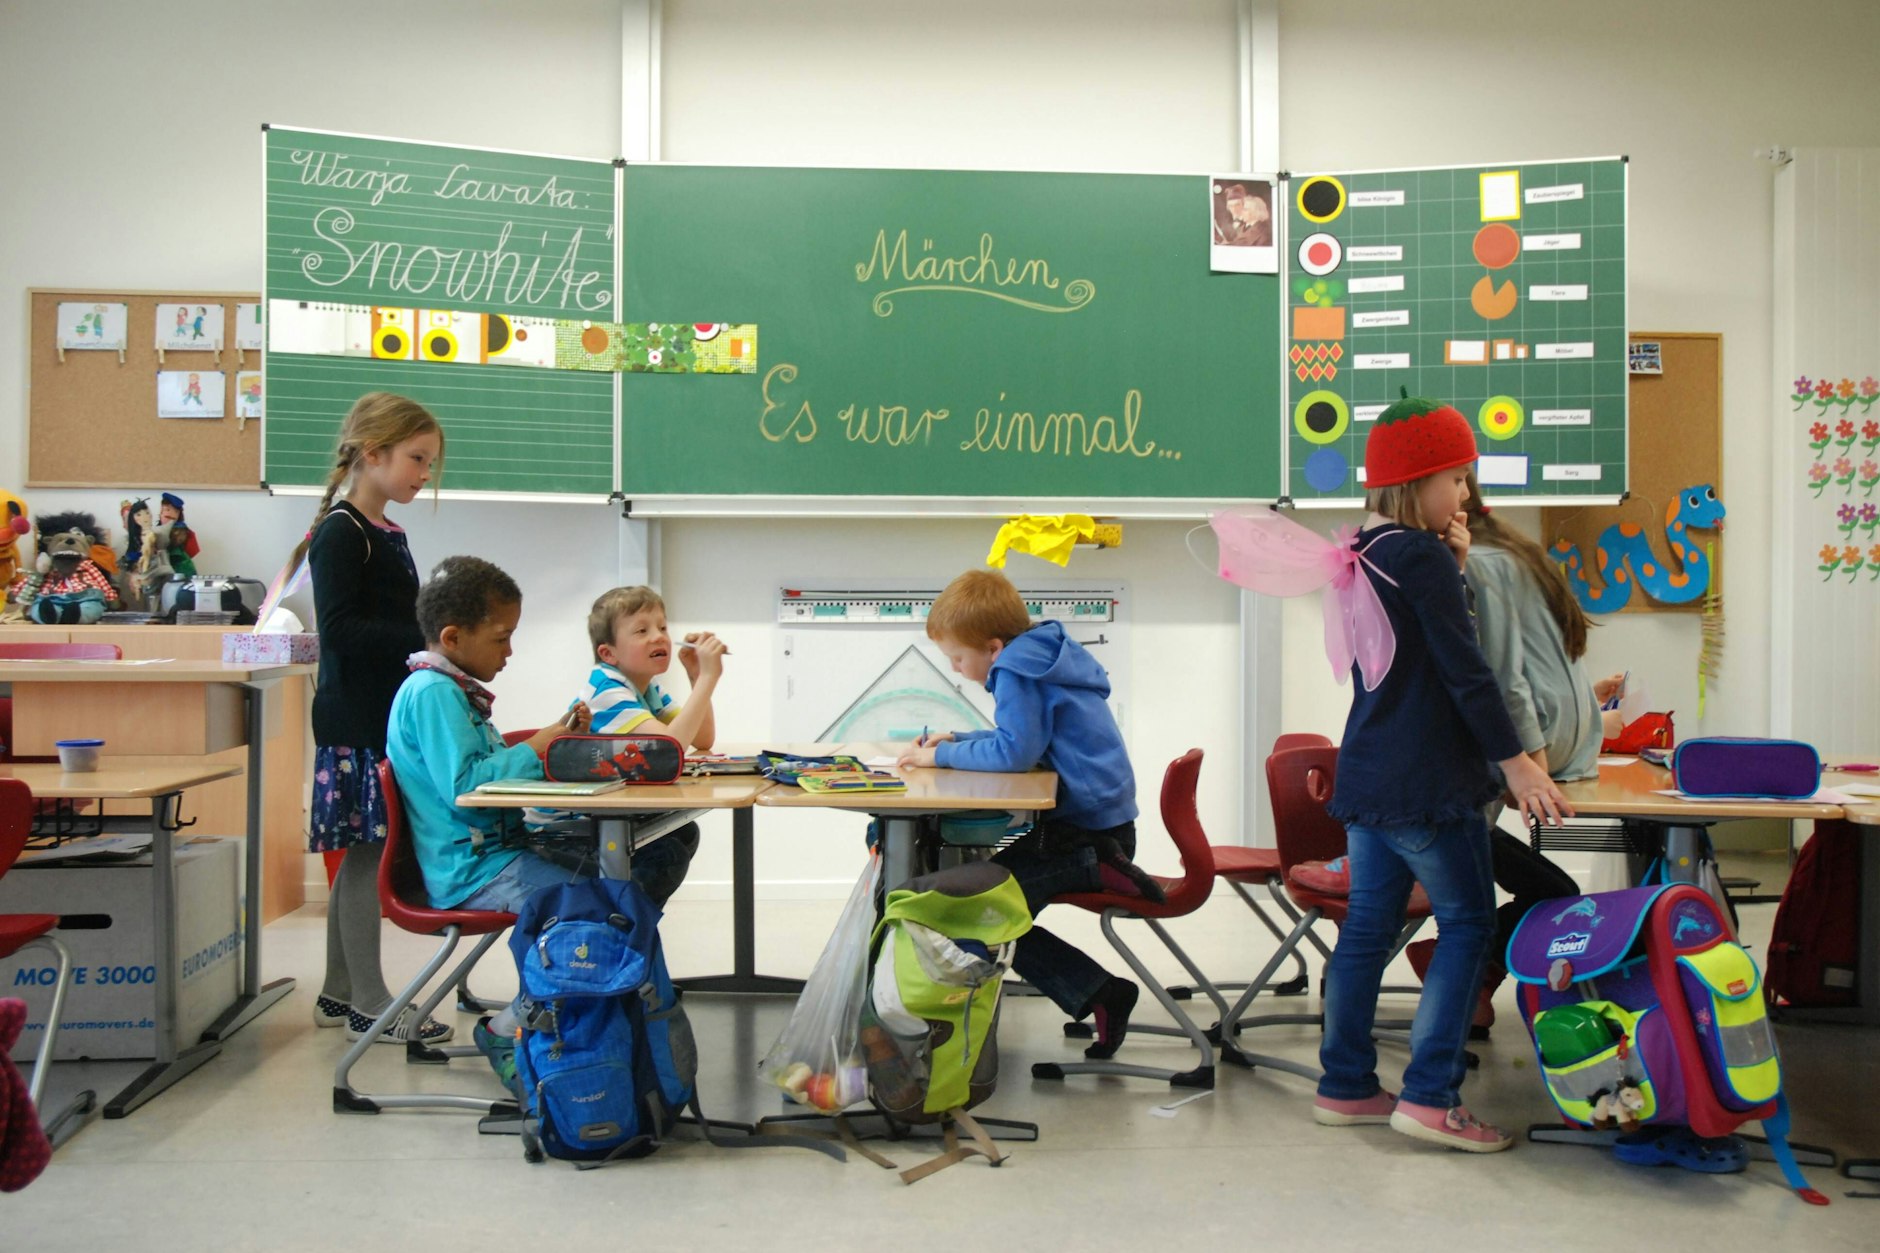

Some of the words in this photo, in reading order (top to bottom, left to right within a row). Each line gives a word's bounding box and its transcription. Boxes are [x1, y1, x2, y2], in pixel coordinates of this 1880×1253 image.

[290, 150, 413, 206] Warja
[856, 228, 1060, 289] Märchen
[758, 363, 818, 443] Es
[837, 403, 950, 446] war
[1095, 606, 1105, 614] 10
[1550, 940, 1585, 954] Scout
[569, 959, 598, 969] deuter
[14, 967, 88, 986] MOE
[95, 966, 156, 985] 3000
[571, 1090, 606, 1103] Junior
